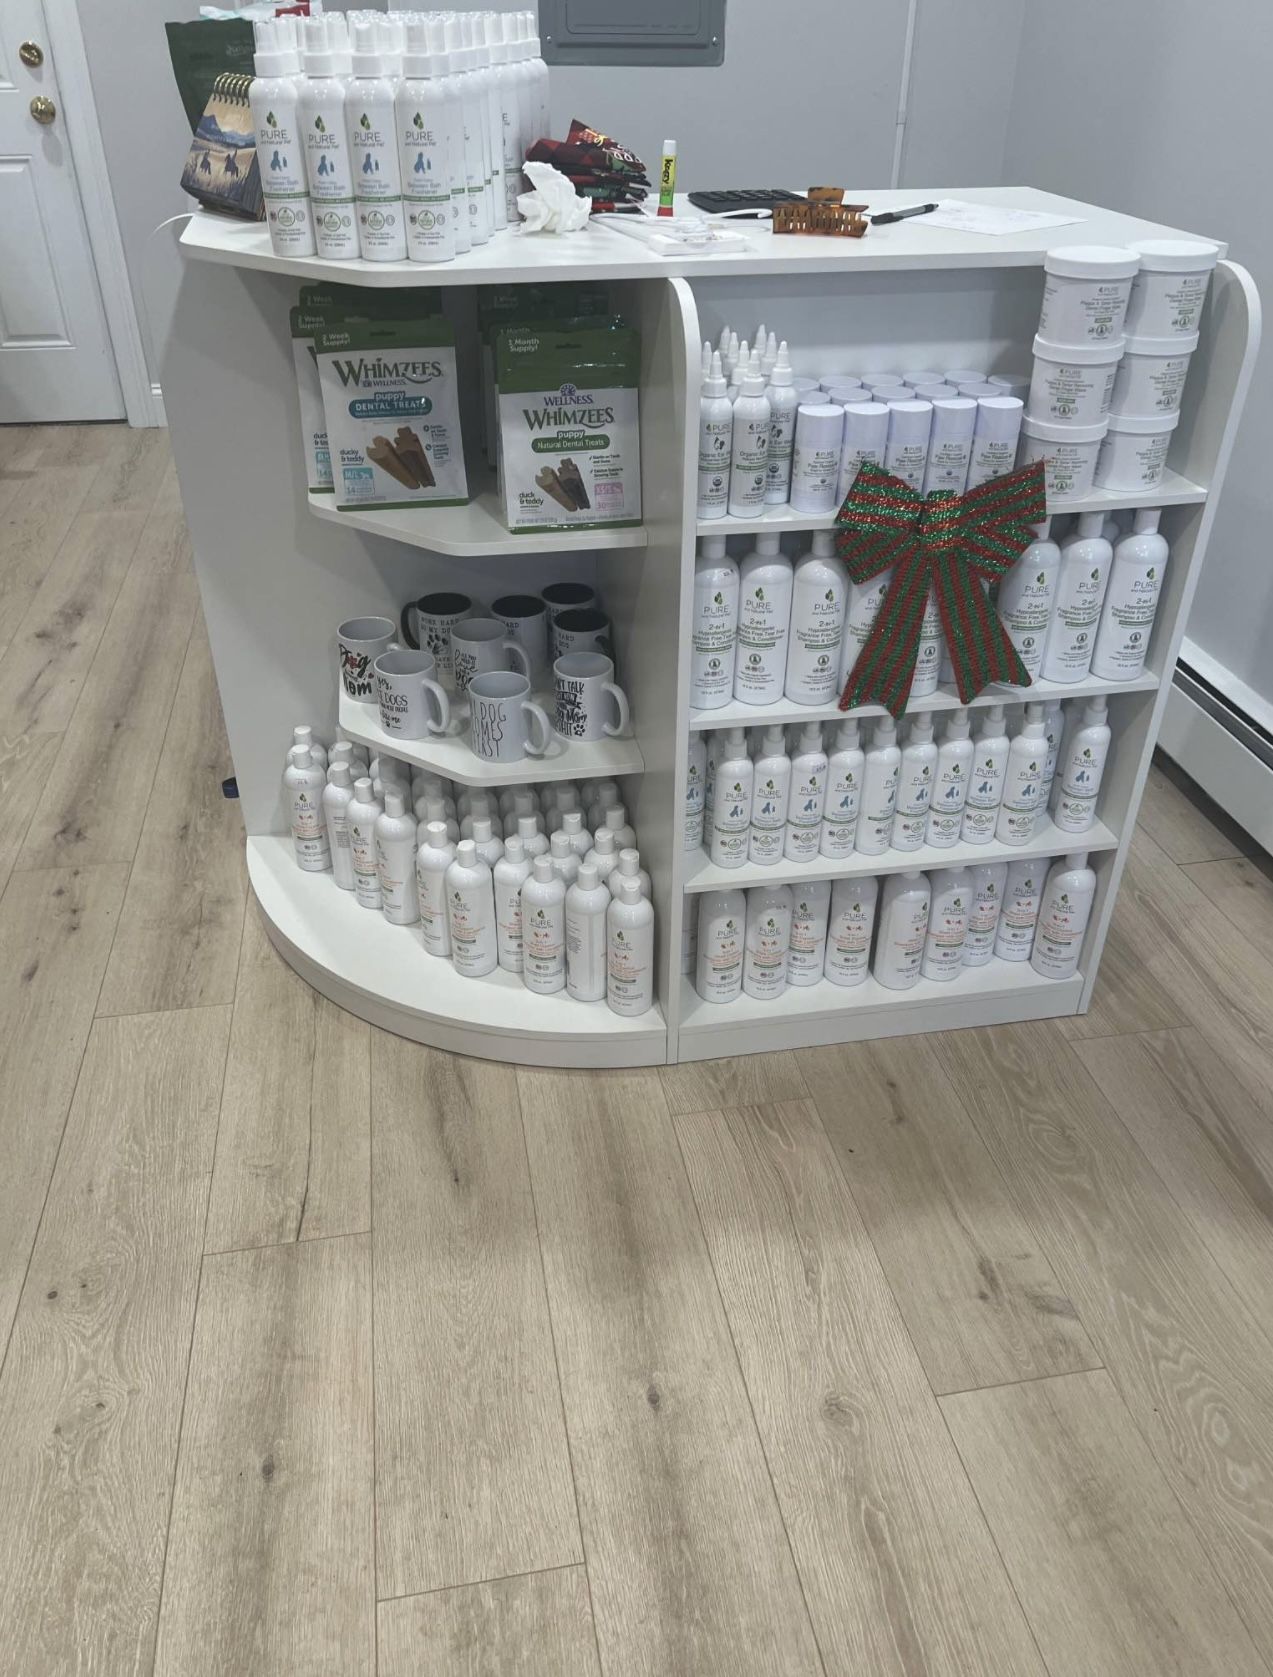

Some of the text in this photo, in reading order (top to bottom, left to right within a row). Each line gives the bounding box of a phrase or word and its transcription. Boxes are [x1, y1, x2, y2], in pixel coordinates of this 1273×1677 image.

[260, 129, 289, 140] PURE
[354, 132, 382, 142] PURE
[405, 131, 433, 141] PURE
[308, 134, 336, 145] PURE
[328, 333, 349, 341] Week
[375, 391, 406, 400] puppy
[543, 394, 594, 406] WELLNESS
[355, 400, 426, 411] DENTAL TREATS
[771, 412, 791, 420] PURE
[557, 430, 586, 439] puppy
[537, 439, 605, 449] Natural Dental Treats
[1134, 580, 1159, 588] PURE
[1024, 585, 1049, 593] PURE
[745, 600, 772, 610] PURE
[814, 601, 841, 611] PURE
[868, 598, 881, 606] PU
[704, 605, 729, 615] PURE
[567, 681, 585, 696] TALK
[384, 692, 409, 706] DOGS
[480, 701, 507, 721] DOG
[1074, 756, 1096, 765] PURE
[976, 767, 1000, 776] PURE
[1020, 771, 1041, 779] PURE
[758, 788, 782, 796] PURE
[800, 786, 823, 794] PURE
[726, 791, 749, 799] PURE
[294, 802, 315, 810] PURE
[1015, 886, 1037, 894] PURE
[1053, 900, 1075, 911] PURE
[792, 910, 815, 918] PURE
[530, 917, 552, 926] PURE
[759, 927, 781, 935] PURE
